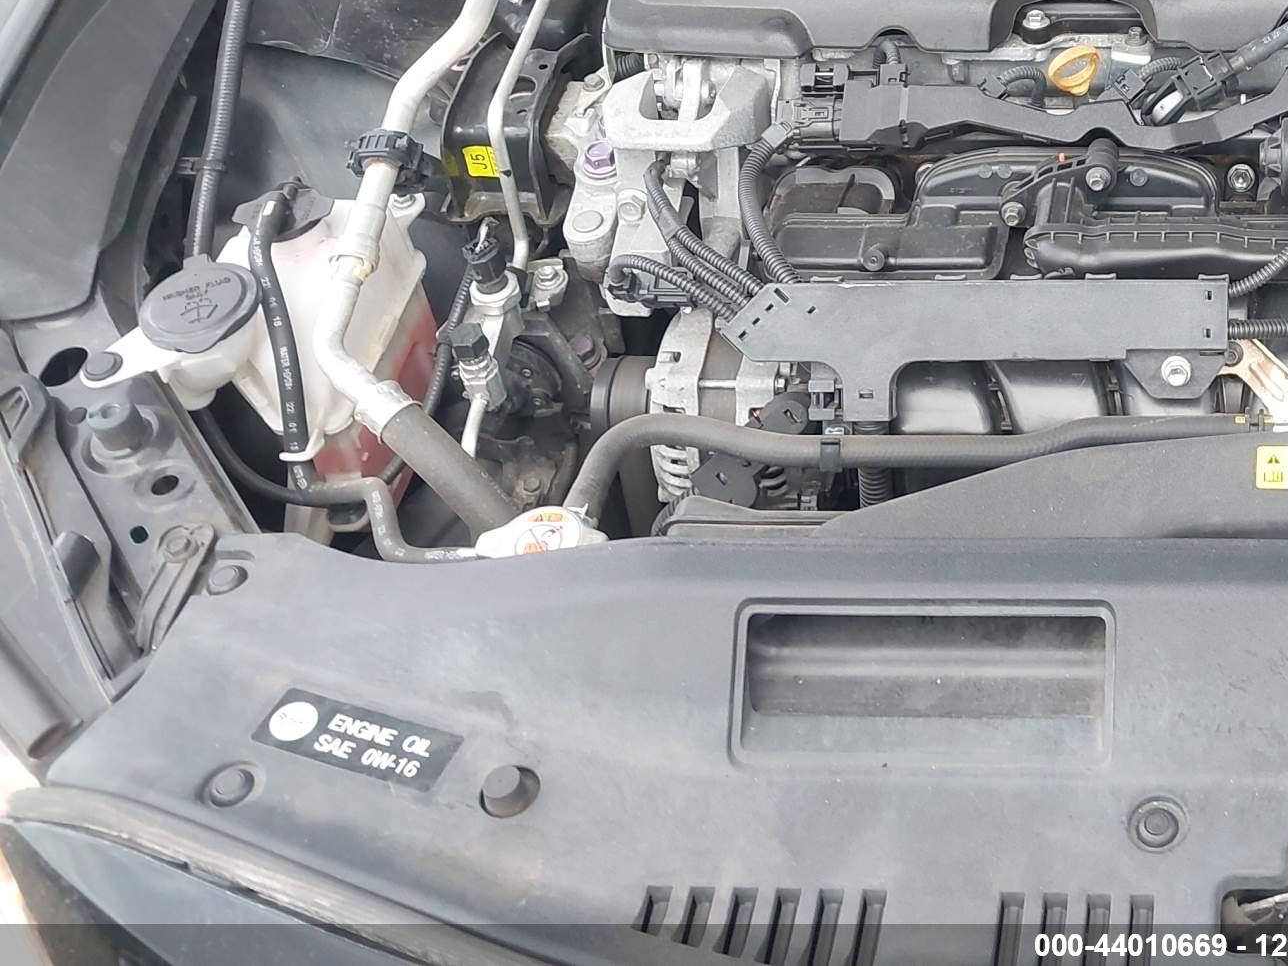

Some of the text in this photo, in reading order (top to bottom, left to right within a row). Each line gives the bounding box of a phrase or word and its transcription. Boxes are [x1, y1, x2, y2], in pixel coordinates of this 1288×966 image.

[470, 153, 488, 170] J5
[313, 734, 421, 778] SAE 0W-16
[328, 713, 431, 757] ENGINE OIL
